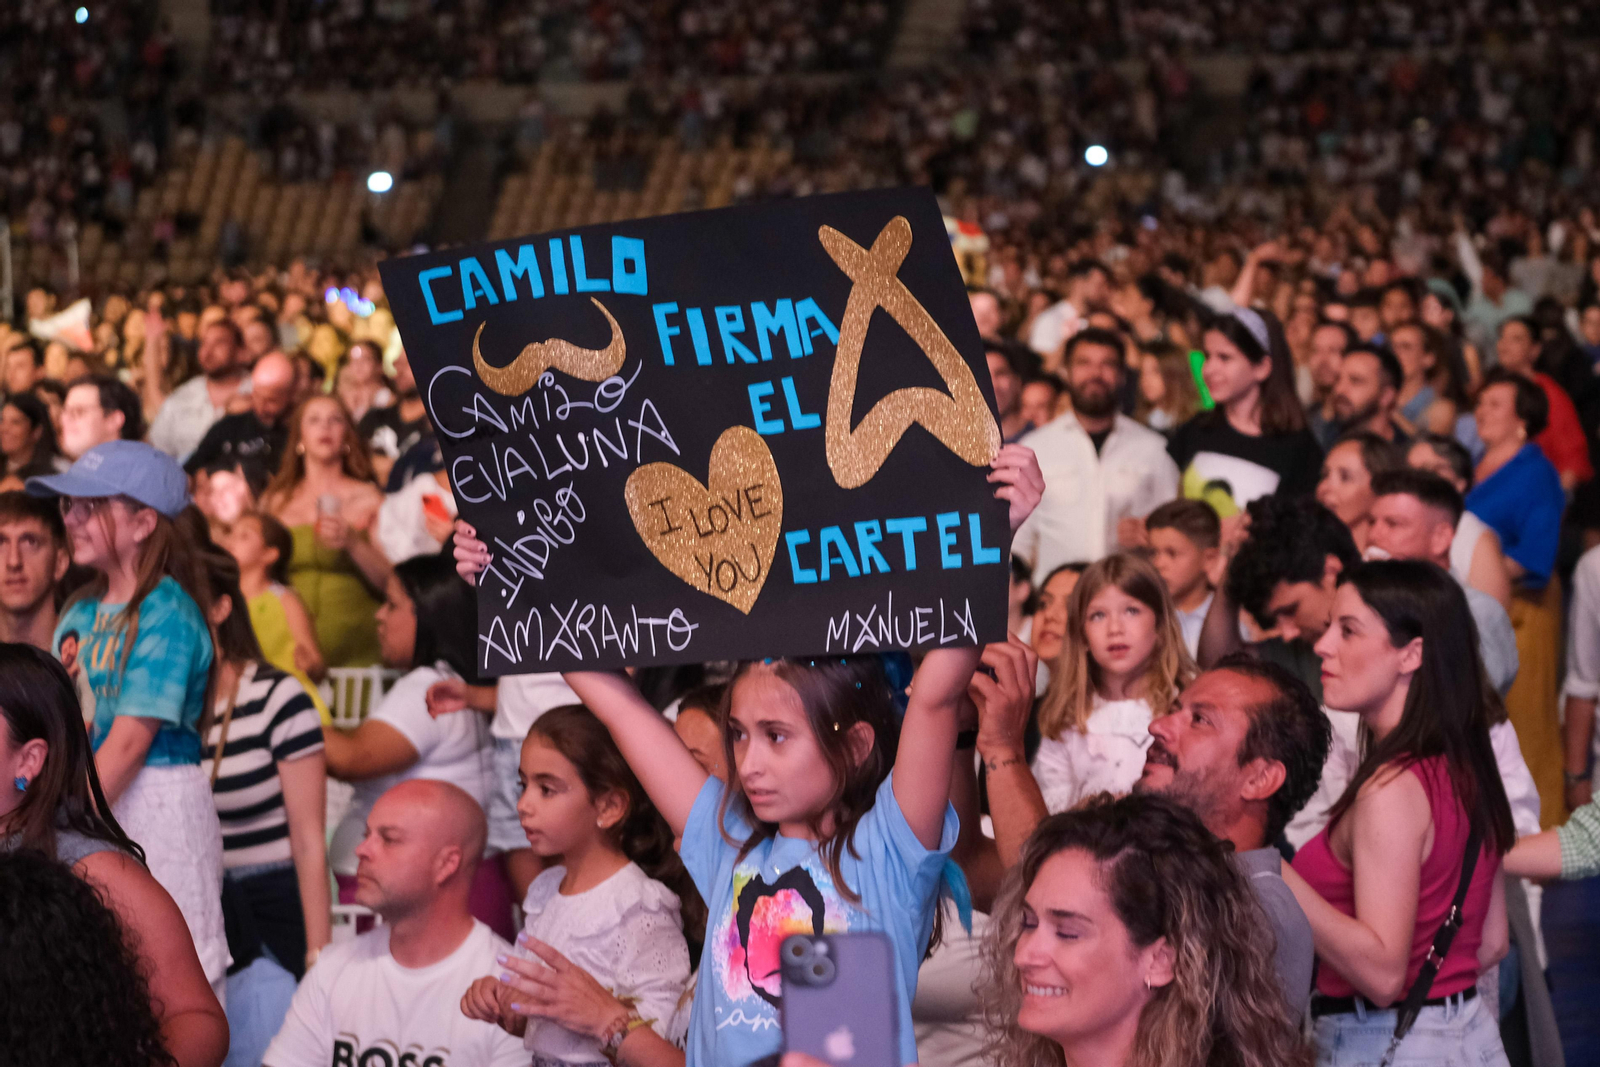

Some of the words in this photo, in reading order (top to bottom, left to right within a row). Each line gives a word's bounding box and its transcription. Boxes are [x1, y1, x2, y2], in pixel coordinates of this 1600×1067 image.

[418, 235, 648, 325] CAMILO
[652, 296, 840, 366] FIRMA
[747, 376, 821, 435] EL
[452, 398, 680, 503] EVALUNA
[647, 496, 682, 536] I
[690, 484, 772, 538] LOVE
[694, 543, 761, 592] YOU
[785, 511, 1000, 584] CARTEL
[478, 599, 699, 669] AMARANTO
[826, 590, 978, 653] MANUELA
